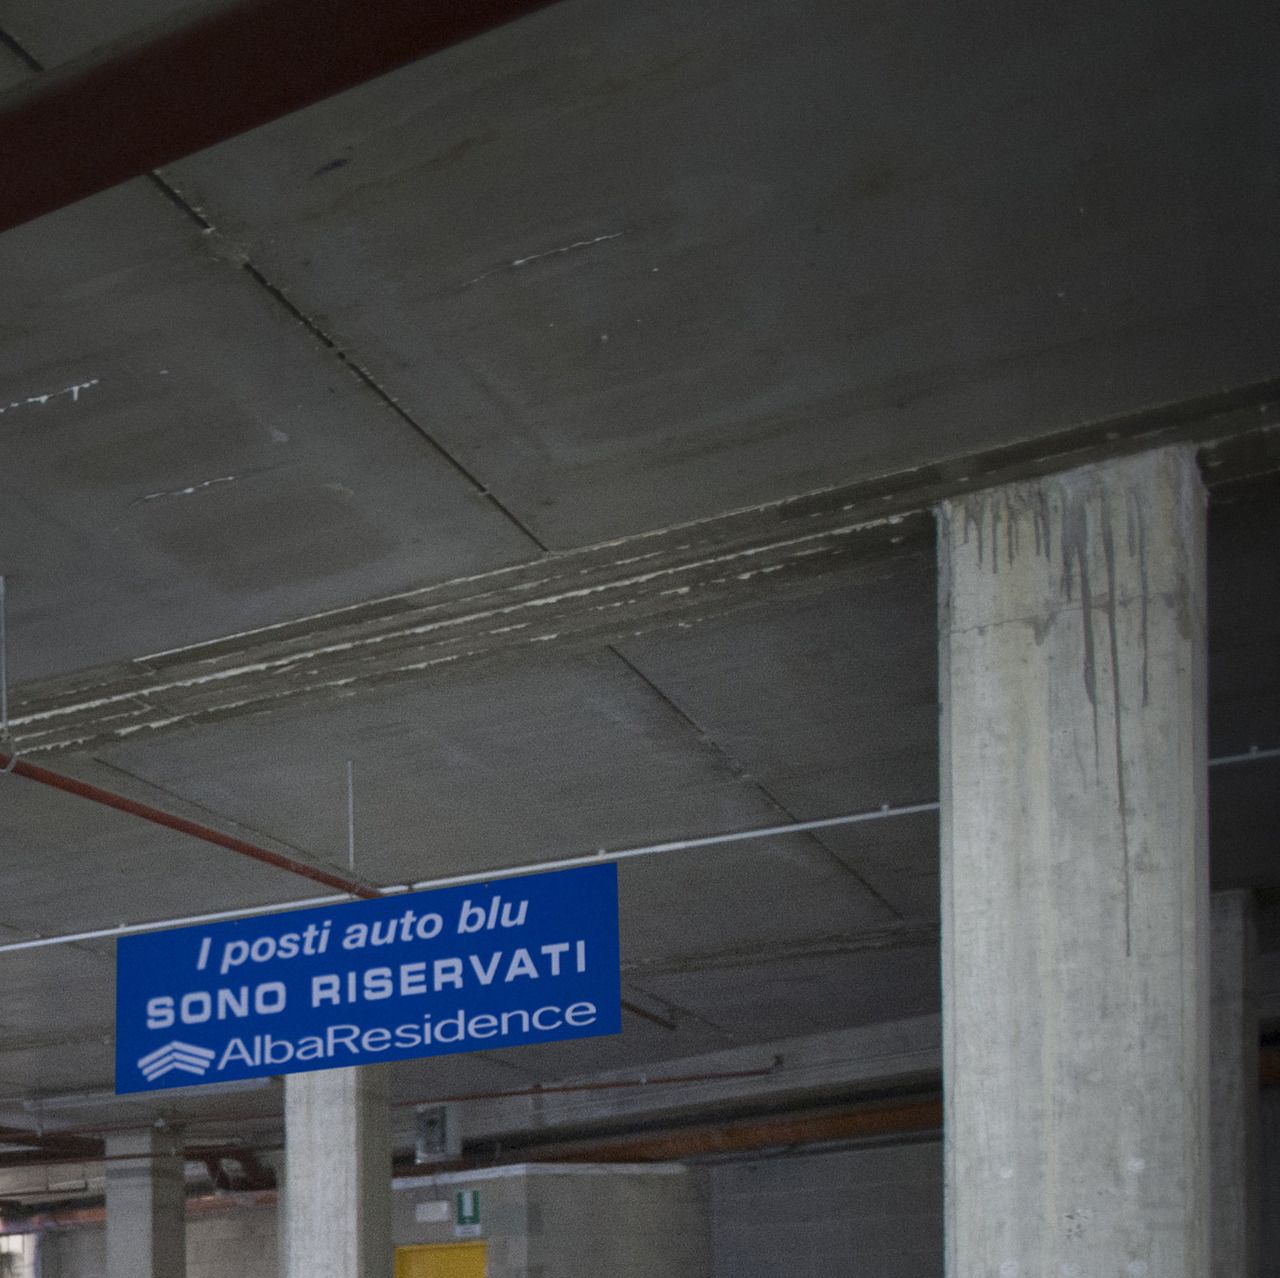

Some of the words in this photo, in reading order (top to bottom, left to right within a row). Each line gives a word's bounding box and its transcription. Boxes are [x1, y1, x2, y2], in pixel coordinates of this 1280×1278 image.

[196, 936, 212, 971] I
[220, 919, 333, 975] posti
[342, 910, 444, 950] auto
[457, 895, 529, 935] blu
[146, 981, 287, 1031] SONO
[311, 940, 586, 1009] RISERVATI
[216, 1001, 598, 1071] AlbaResidence
